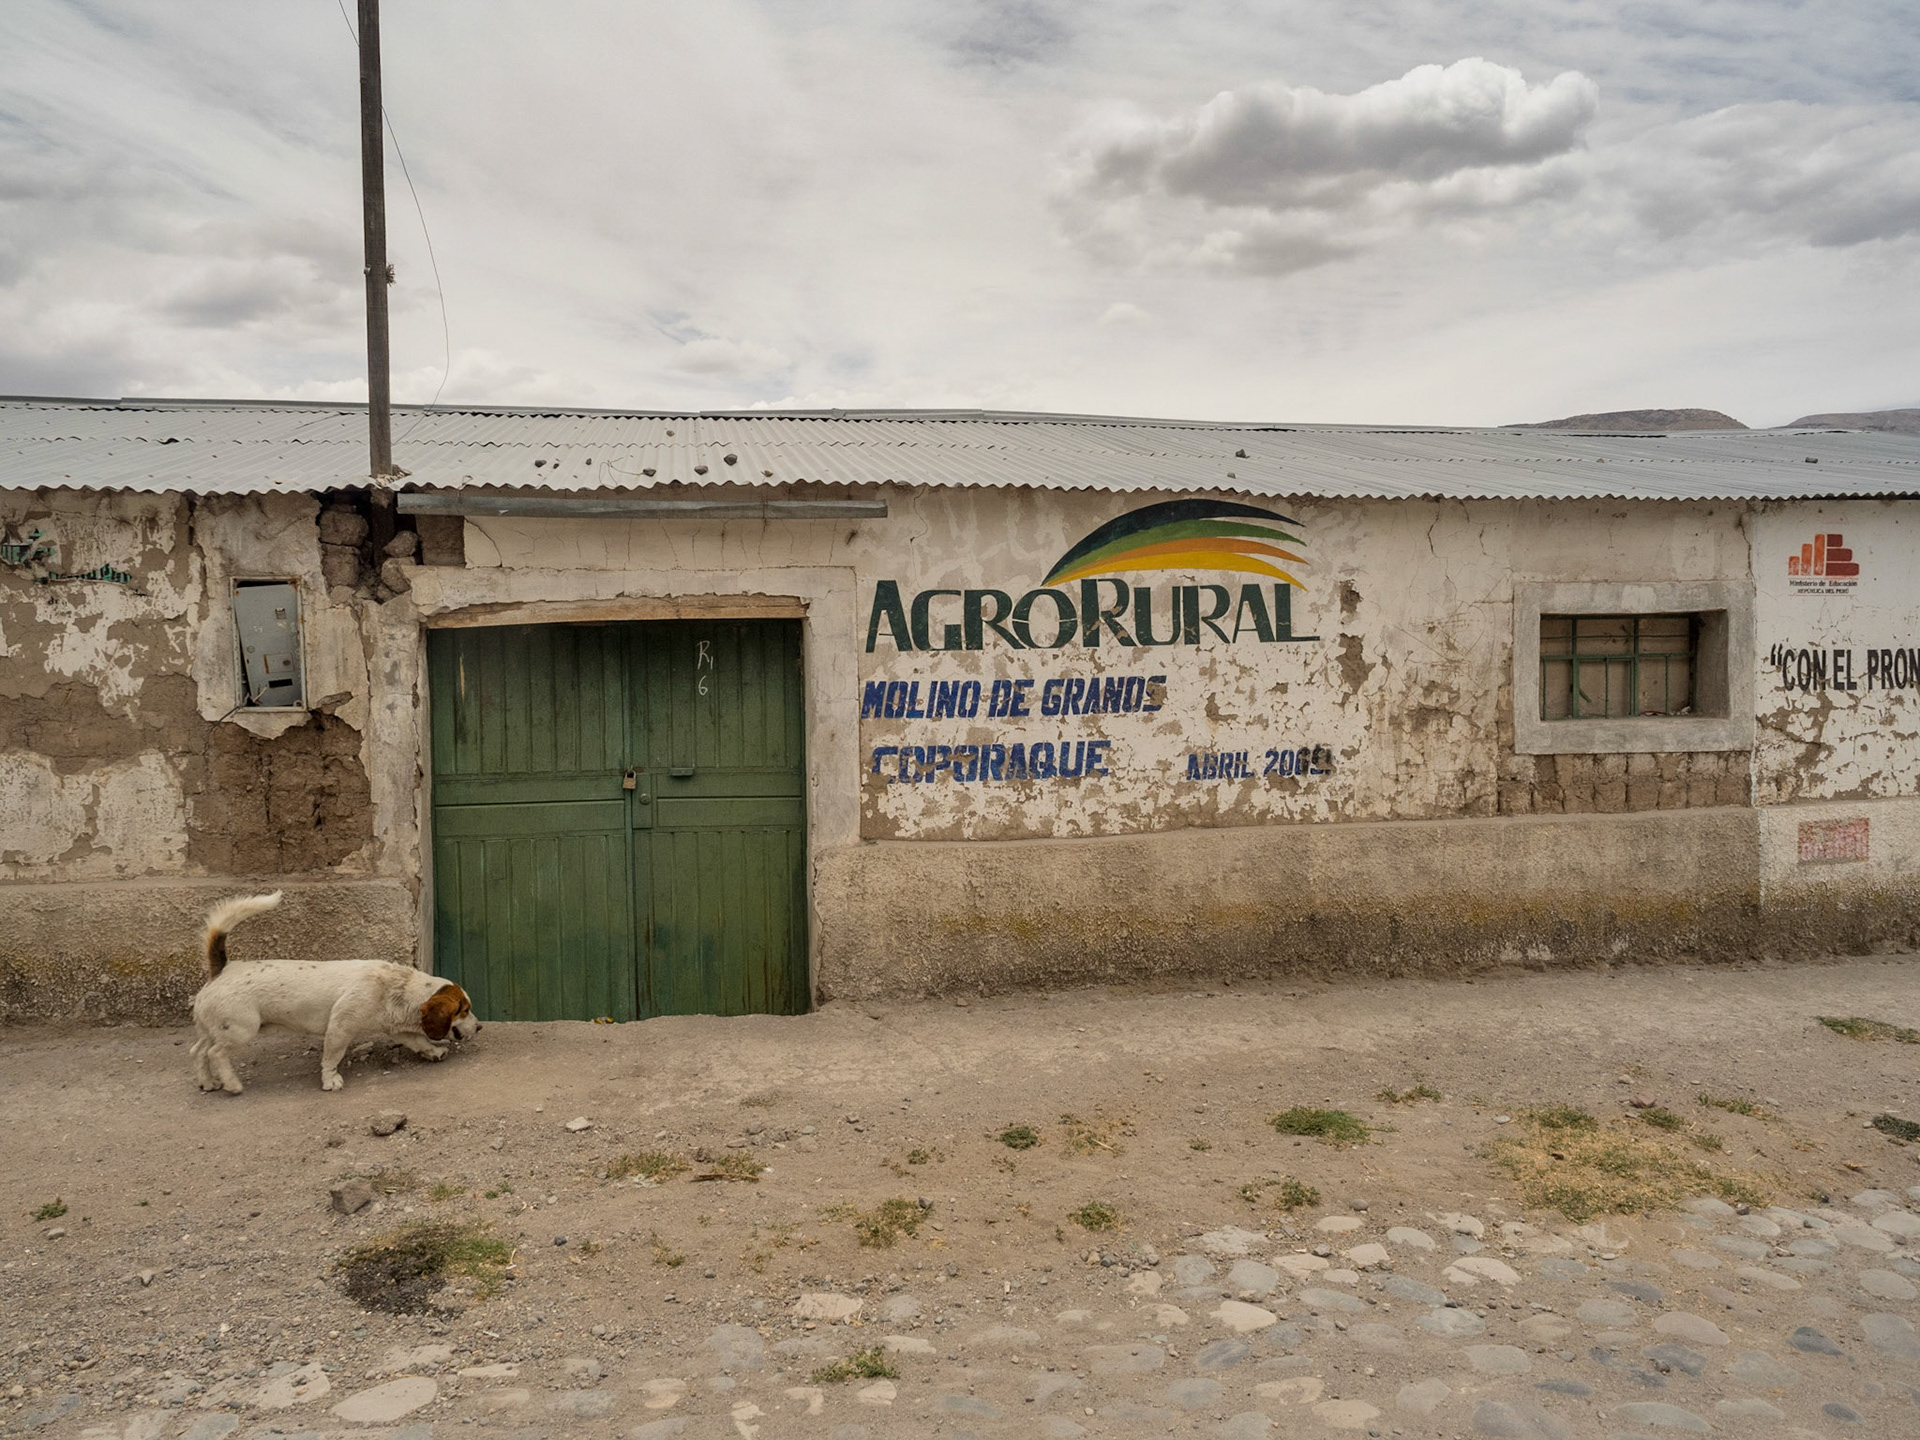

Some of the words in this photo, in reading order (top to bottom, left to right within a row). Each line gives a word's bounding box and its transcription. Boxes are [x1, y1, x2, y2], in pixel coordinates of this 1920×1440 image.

[865, 578, 1320, 653] AGRORURAL
[698, 675, 708, 696] 6
[1833, 649, 1857, 690] EL
[861, 680, 982, 719] MOLINO
[987, 679, 1035, 717] DE
[1040, 675, 1167, 716] GRANOS
[871, 740, 1112, 785] COPORAQUE
[1186, 751, 1255, 781] ABRIL
